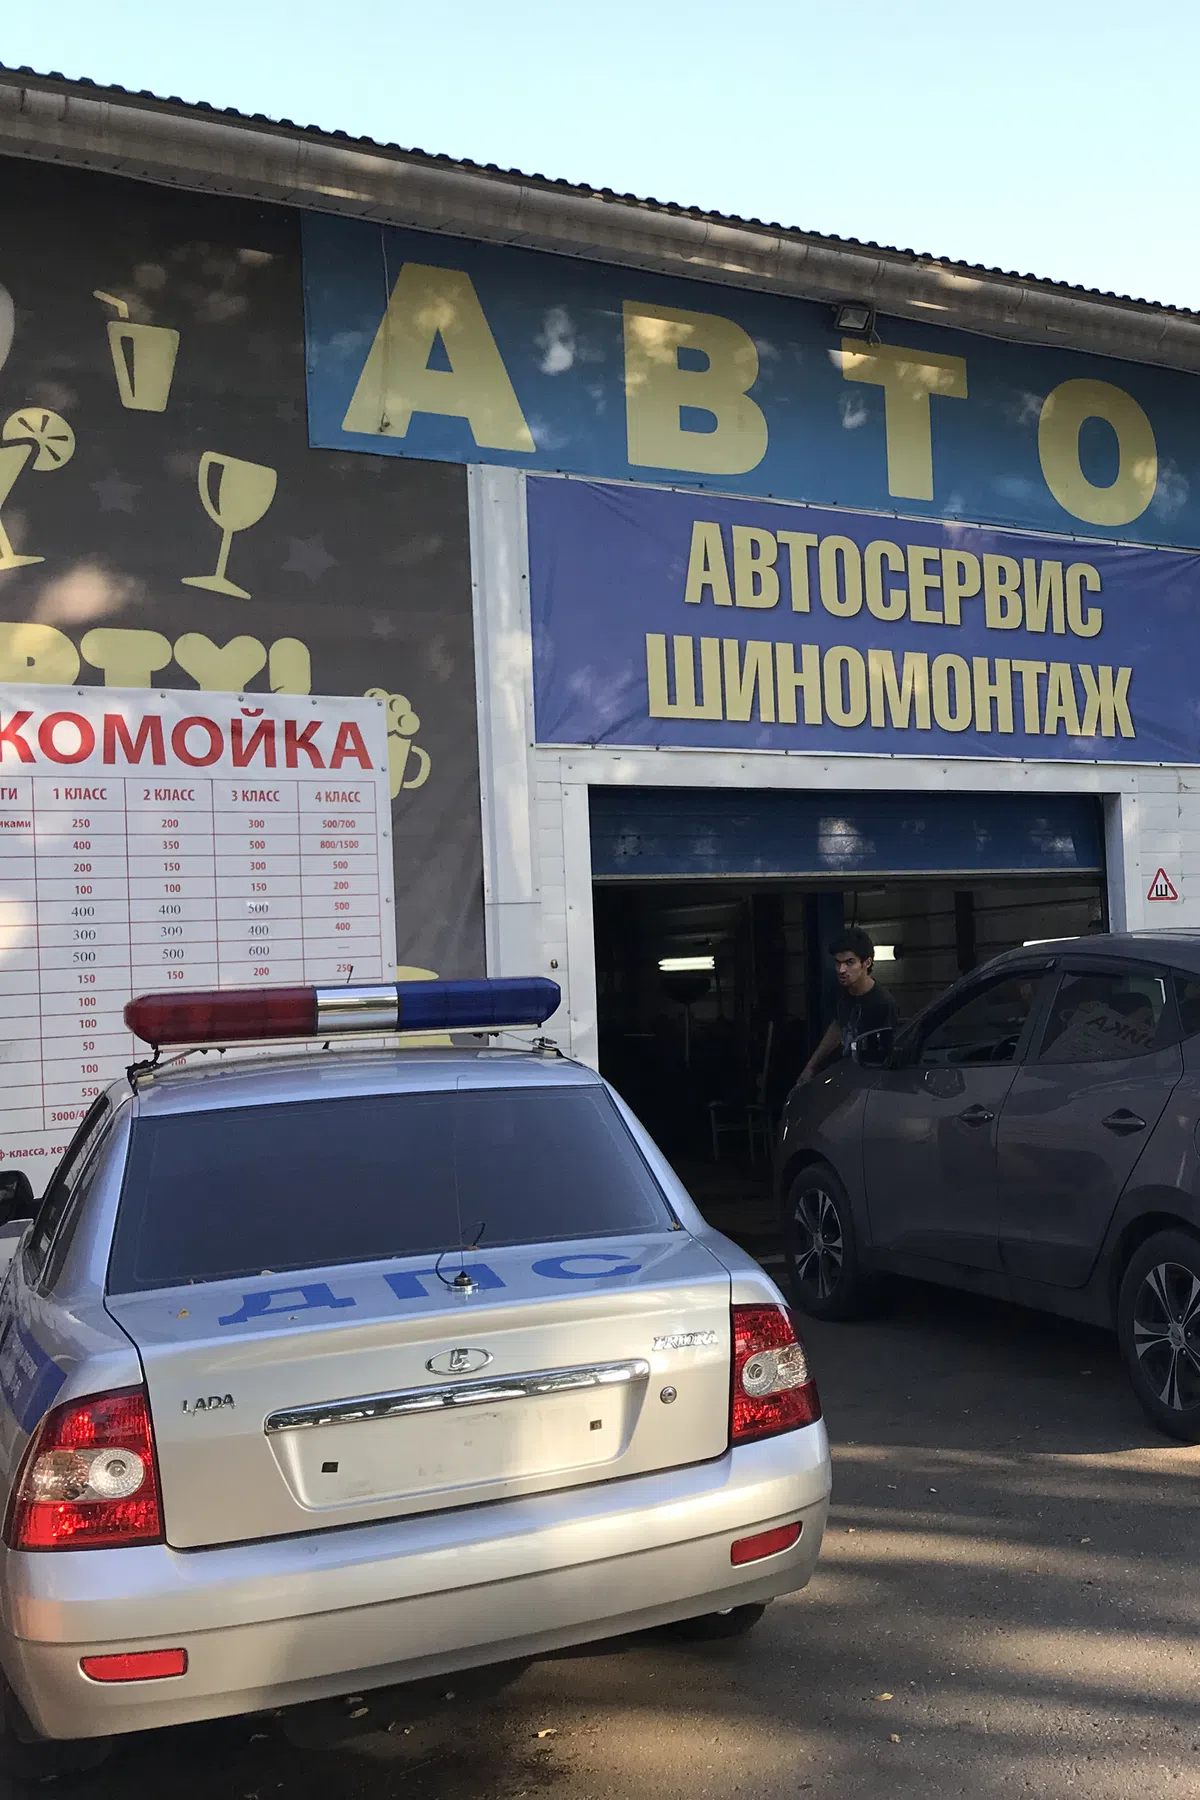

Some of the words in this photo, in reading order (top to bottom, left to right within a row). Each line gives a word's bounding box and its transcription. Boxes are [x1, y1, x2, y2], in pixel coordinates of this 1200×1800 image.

[684, 520, 1103, 638] АВТОСЕРВИС
[645, 632, 1136, 739] ШИНОМОНТАЖ
[0, 708, 374, 770] КОМОЙКА
[53, 788, 60, 800] 1
[65, 788, 108, 800] КЛАСС
[143, 789, 150, 800] 2
[155, 790, 195, 801] КЛАСС
[232, 790, 238, 801] 3
[242, 790, 280, 802] КЛАСС
[315, 792, 322, 802] 4
[326, 791, 360, 803] КЛАСС
[72, 819, 90, 828] 250
[162, 819, 179, 828] 200
[249, 819, 264, 828] 300
[322, 820, 356, 828] 500/700
[73, 841, 91, 850] 400
[162, 841, 180, 849] 350
[250, 841, 265, 849] 500
[320, 840, 359, 849] 800/1500
[74, 864, 92, 872] 200
[164, 862, 180, 871] 150
[250, 862, 266, 870] 300
[333, 861, 348, 869] 500
[164, 884, 181, 892] 100
[251, 883, 267, 891] 150
[334, 881, 349, 889] 200
[75, 886, 92, 894] 100
[158, 905, 181, 914] 400
[248, 902, 269, 913] 500
[334, 902, 349, 910] 500
[71, 907, 95, 917] 400
[248, 925, 269, 935] 400
[335, 922, 350, 930] 400
[73, 930, 96, 940] 300
[160, 926, 182, 937] 300
[162, 949, 184, 959] 500
[249, 946, 270, 956] 600
[72, 952, 96, 962] 500
[254, 967, 269, 976] 200
[336, 964, 352, 972] 250
[78, 975, 96, 983] 150
[167, 971, 183, 979] 150
[78, 998, 96, 1007] 100
[79, 1020, 97, 1028] 100
[83, 1042, 94, 1050] 50
[81, 1064, 98, 1073] 100
[81, 1087, 99, 1096] 550
[218, 1254, 642, 1326] ДПС
[182, 1394, 236, 1416] LADA
